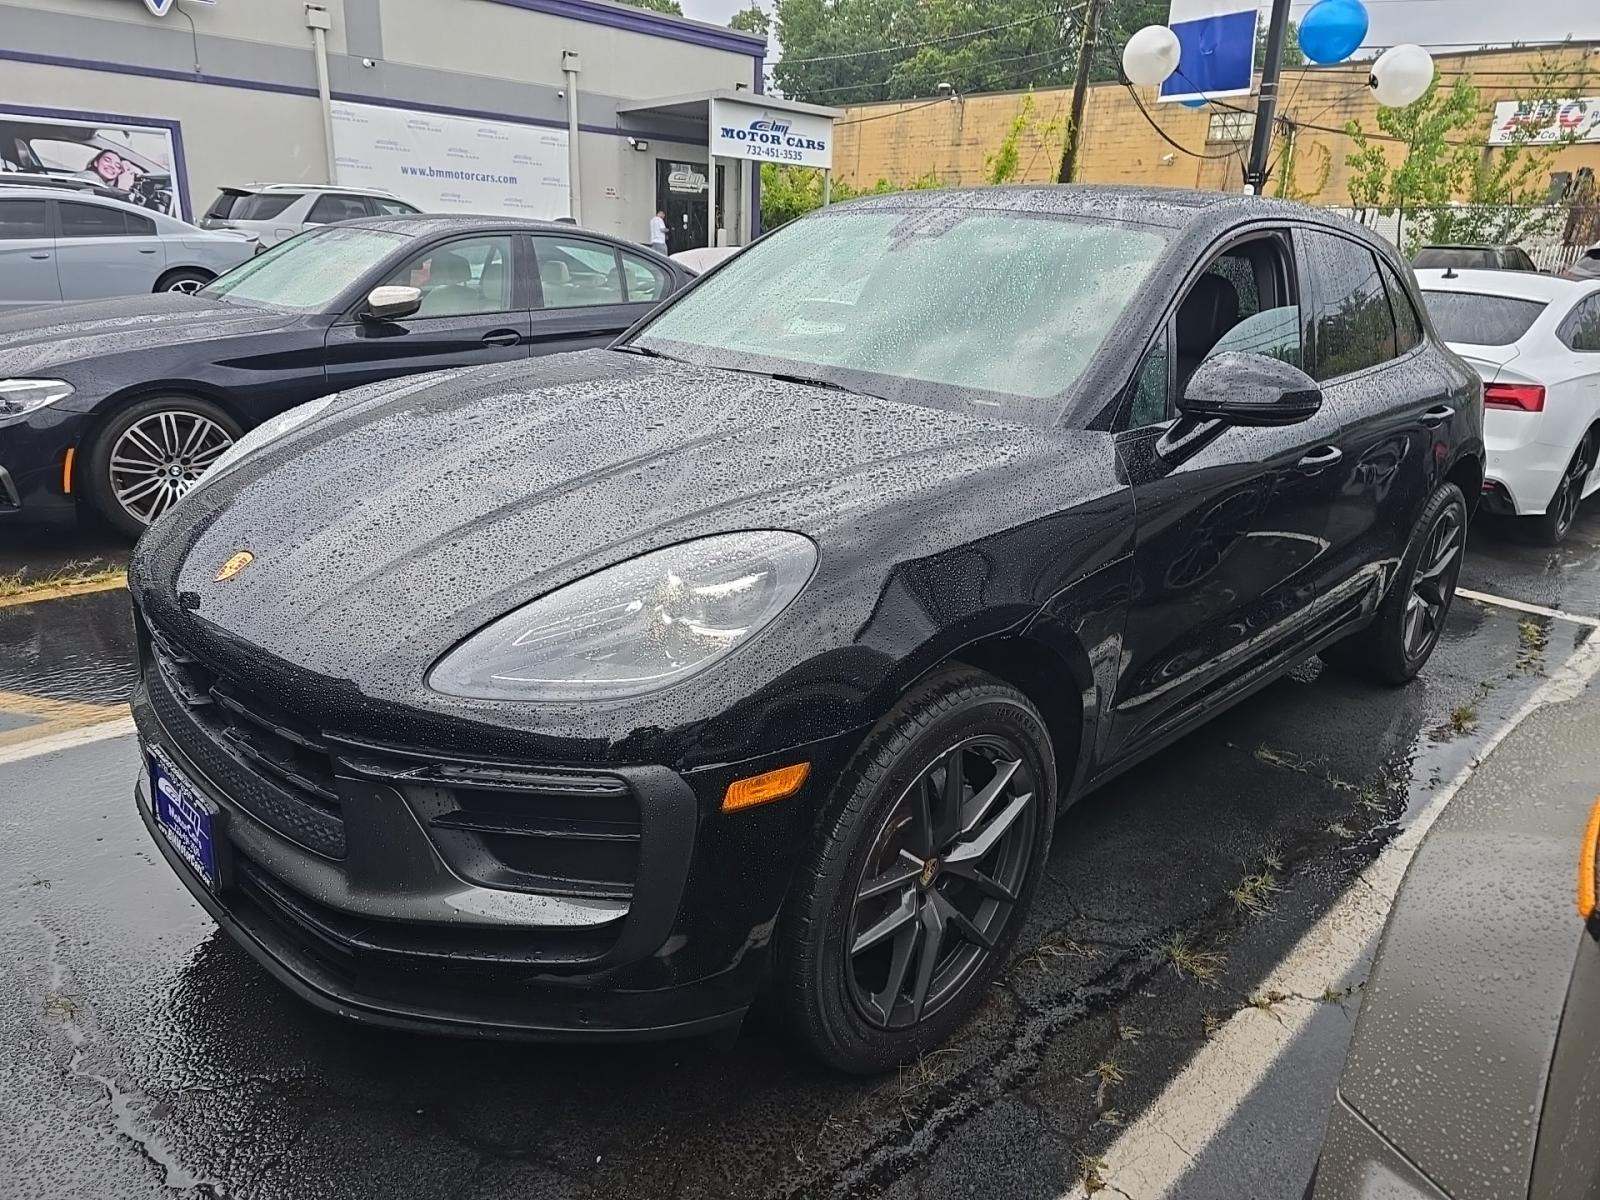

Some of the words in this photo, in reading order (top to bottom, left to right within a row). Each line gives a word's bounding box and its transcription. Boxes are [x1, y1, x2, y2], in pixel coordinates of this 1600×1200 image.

[720, 127, 782, 146] MOTOR
[786, 136, 826, 151] CARS
[746, 144, 803, 161] 732-451-3535
[400, 165, 518, 185] www.bmmotorcars.com
